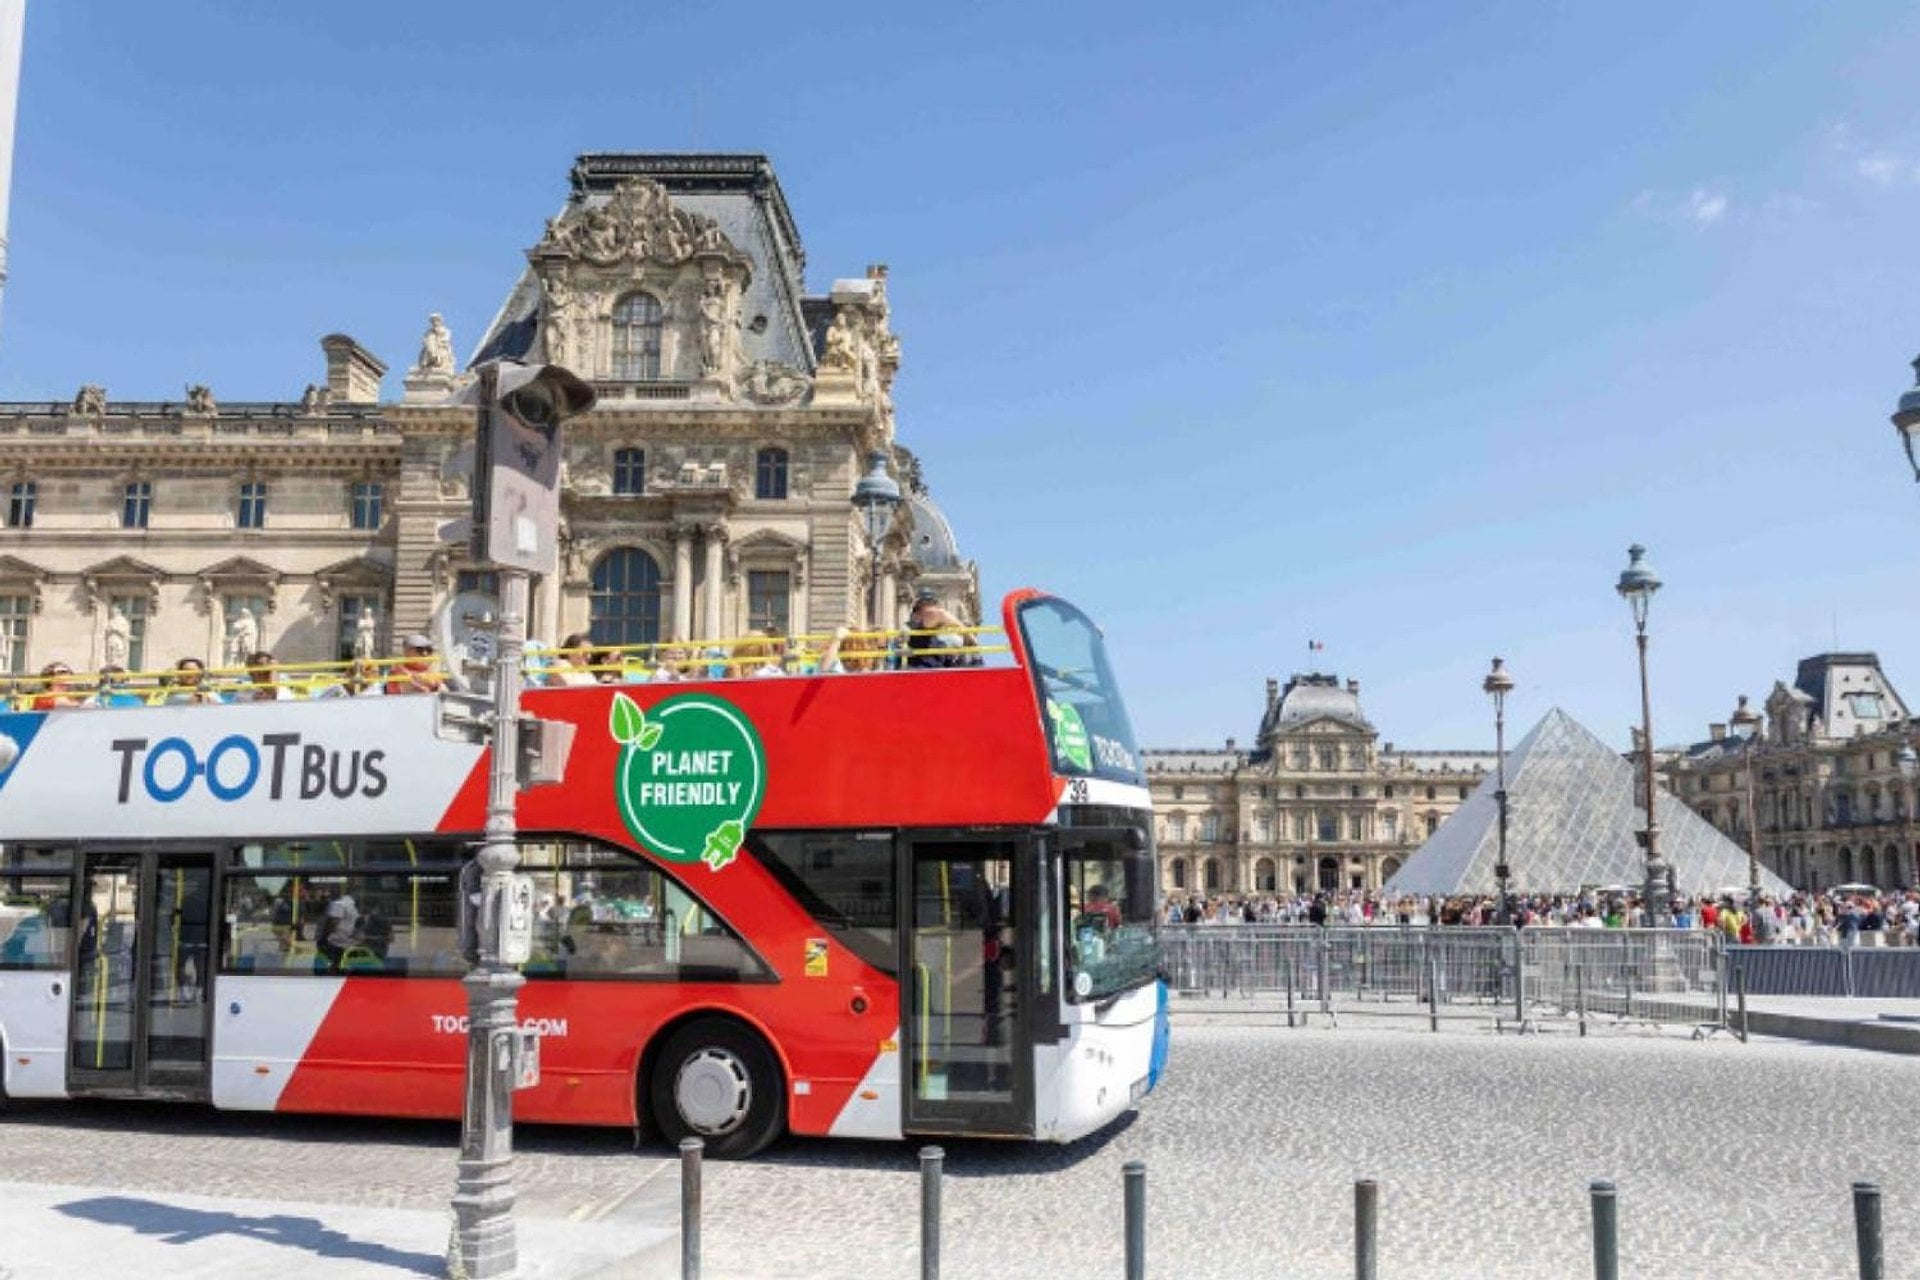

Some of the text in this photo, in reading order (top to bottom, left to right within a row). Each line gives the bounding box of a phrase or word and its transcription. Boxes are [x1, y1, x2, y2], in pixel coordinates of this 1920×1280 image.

[652, 750, 733, 775] PLANET
[641, 782, 740, 806] FRIENDLY
[1069, 779, 1088, 802] 39
